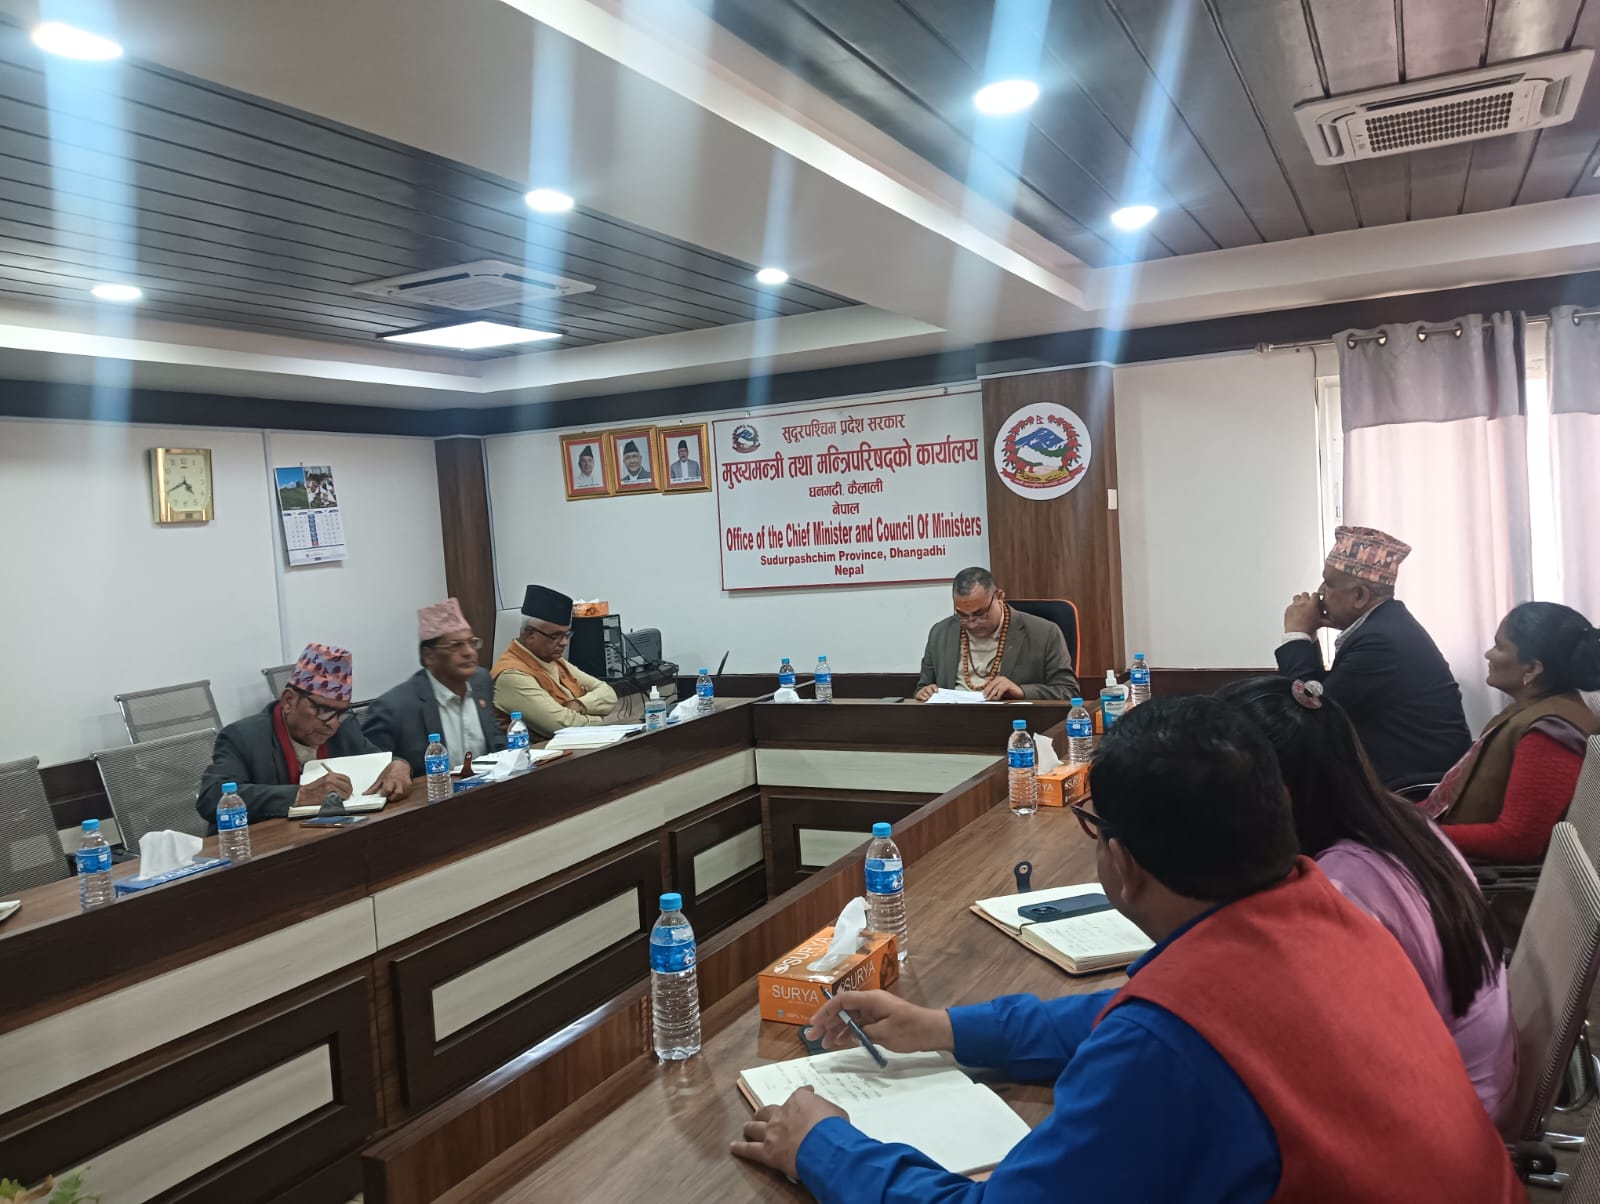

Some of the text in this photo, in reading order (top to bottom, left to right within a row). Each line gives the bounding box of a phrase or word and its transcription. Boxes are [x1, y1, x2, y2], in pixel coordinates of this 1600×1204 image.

[840, 415, 865, 435] प्रदेश
[867, 414, 906, 431] सरकार
[722, 451, 784, 489] मुख्यमन्त्री
[788, 454, 813, 478] तथा
[916, 435, 979, 465] कार्यालय
[832, 501, 860, 515] नेपाल
[726, 511, 982, 551] Office of the Chief Minister and Council Of Ministers
[760, 544, 946, 566] Sudurpashchim Province, Dhangadhi
[834, 563, 864, 577] Nepal
[843, 959, 876, 991] SURYA
[771, 984, 819, 1004] SURYA
